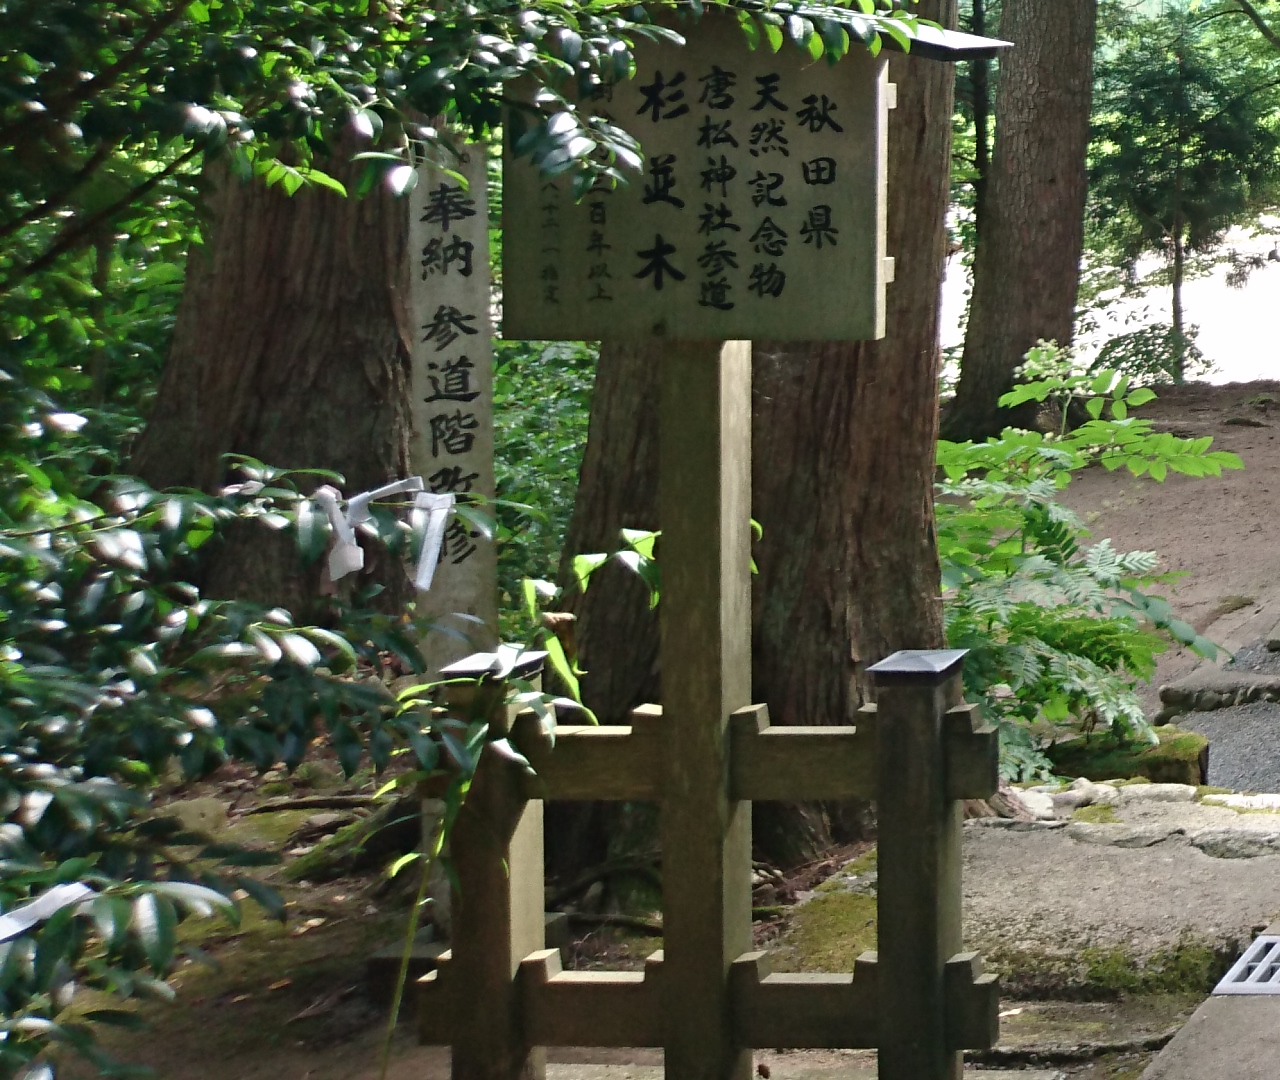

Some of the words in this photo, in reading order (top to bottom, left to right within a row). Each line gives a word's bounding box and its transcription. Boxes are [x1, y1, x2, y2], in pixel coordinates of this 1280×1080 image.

[419, 182, 477, 281] 奉納
[634, 70, 690, 291] 杉並木
[697, 65, 741, 311] 唐松神社参道
[748, 72, 790, 299] 天然記念物
[796, 94, 844, 249] 秋田県
